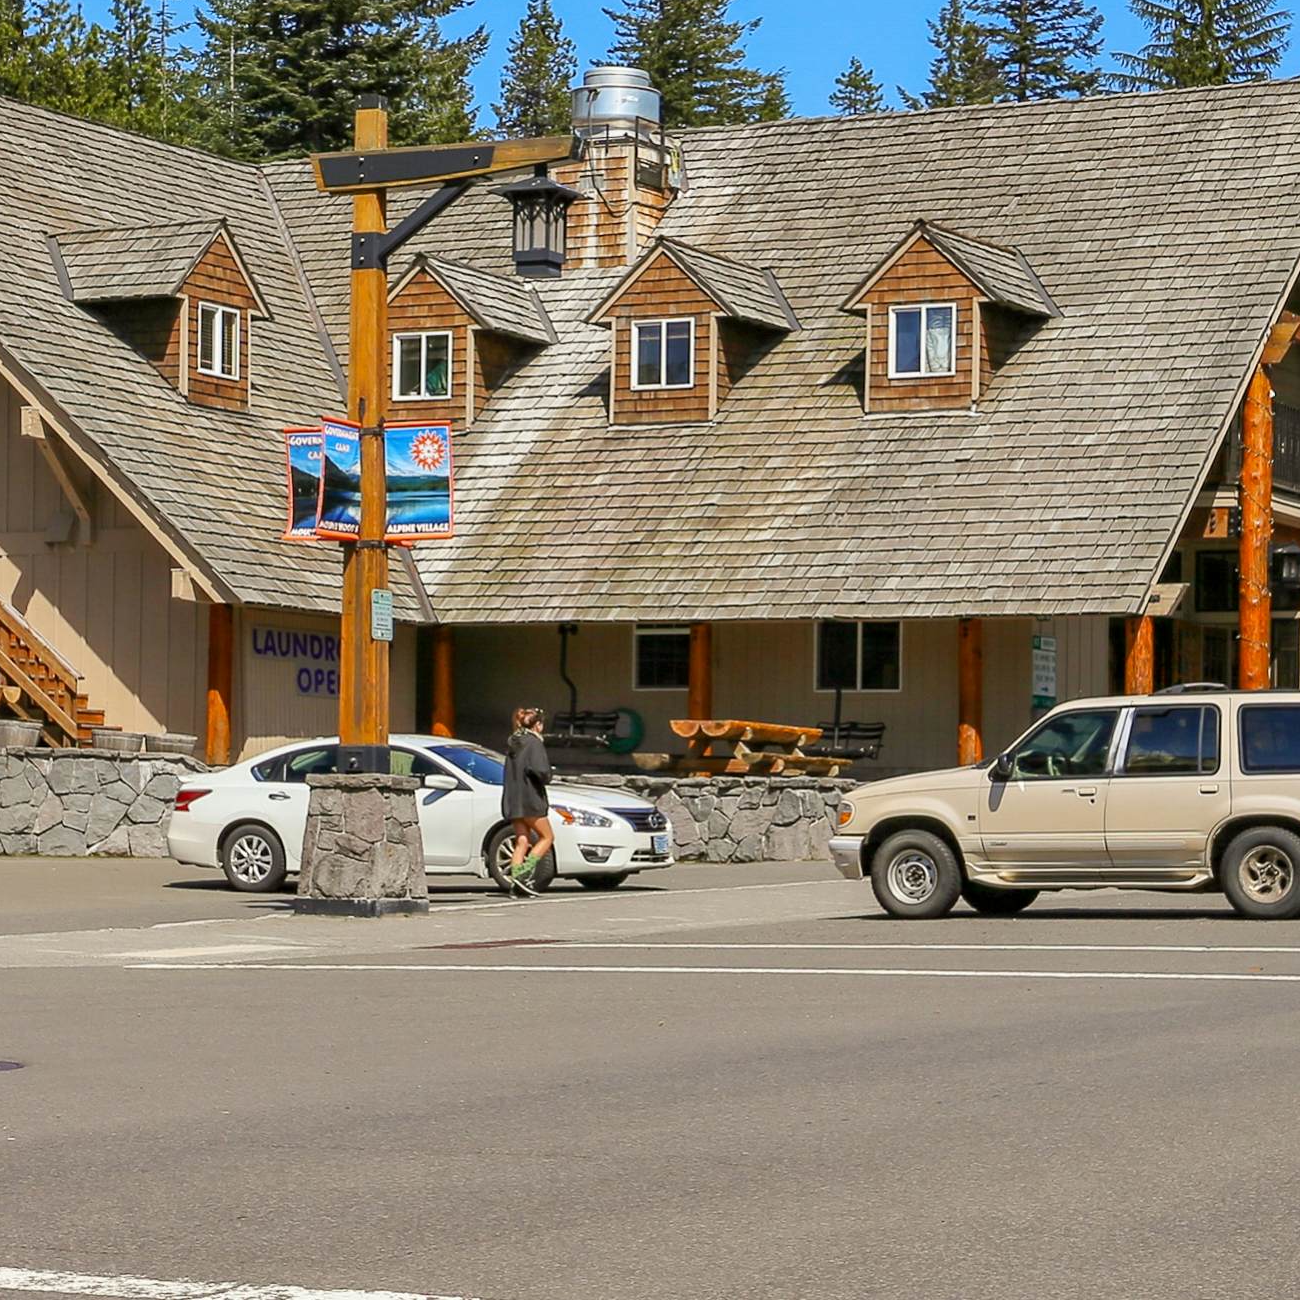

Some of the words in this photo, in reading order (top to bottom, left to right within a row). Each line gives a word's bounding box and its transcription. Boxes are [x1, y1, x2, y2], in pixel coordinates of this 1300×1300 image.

[387, 524, 416, 534] ALPINE
[416, 522, 449, 533] VILLAGE
[253, 628, 340, 661] LAUNDR
[297, 668, 340, 694] OPE
